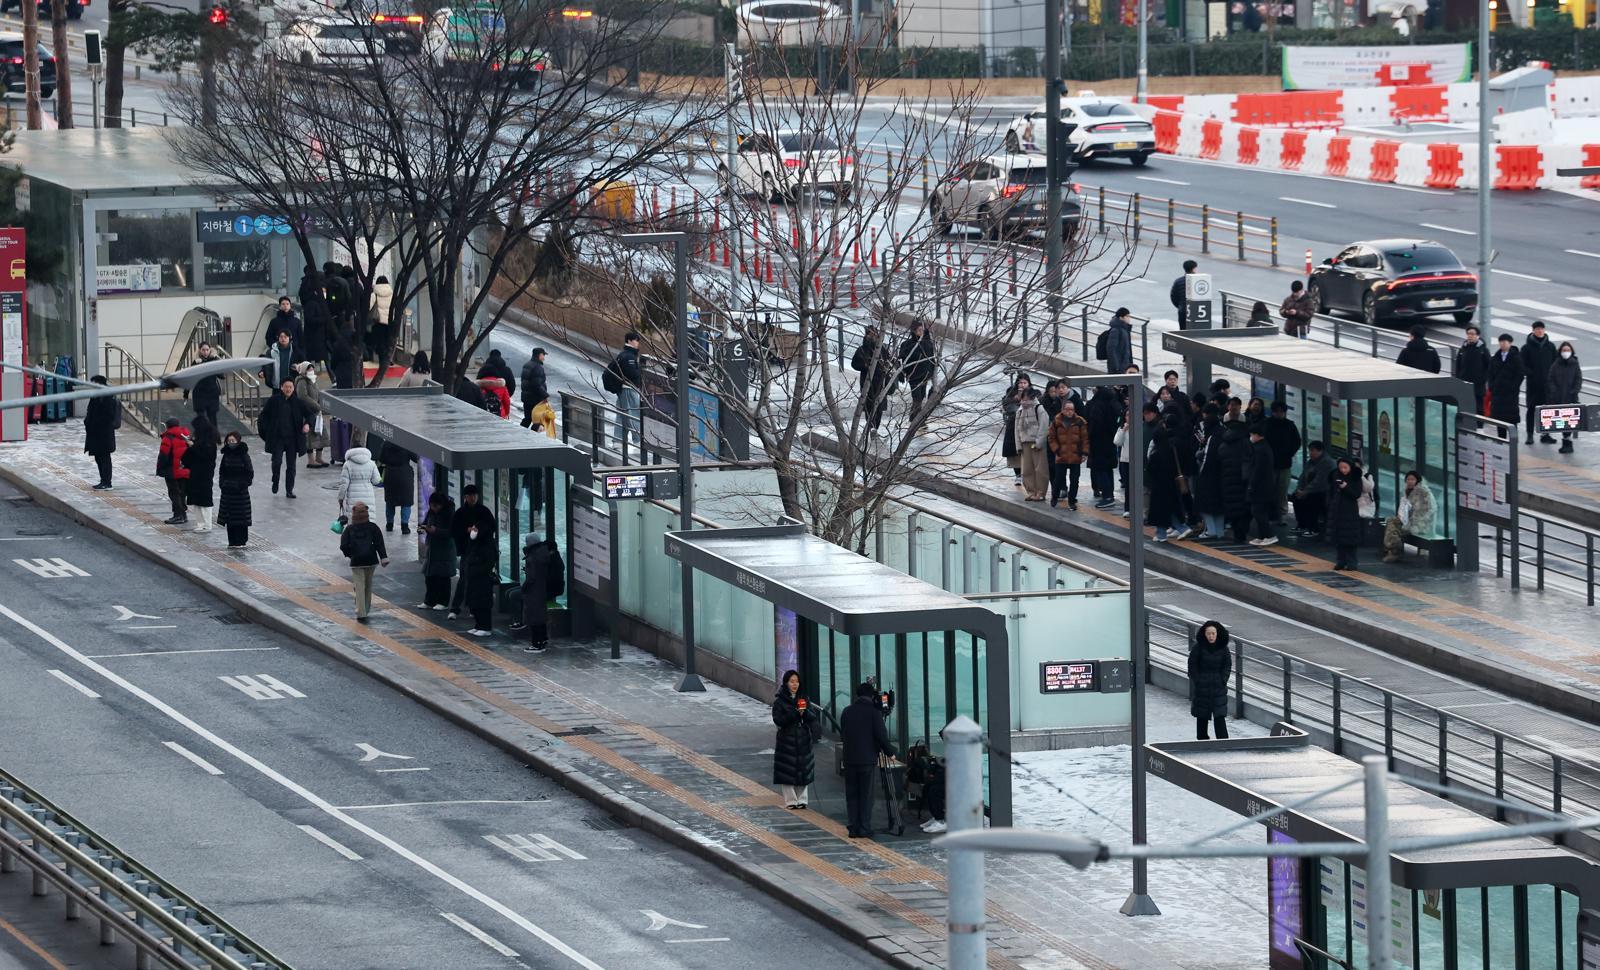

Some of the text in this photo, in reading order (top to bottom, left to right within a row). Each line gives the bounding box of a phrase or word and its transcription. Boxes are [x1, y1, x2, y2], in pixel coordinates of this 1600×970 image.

[202, 220, 232, 233] 지하철
[240, 220, 247, 233] 1
[1197, 304, 1207, 318] 5
[733, 343, 743, 357] 6
[1247, 799, 1260, 816] 서울역
